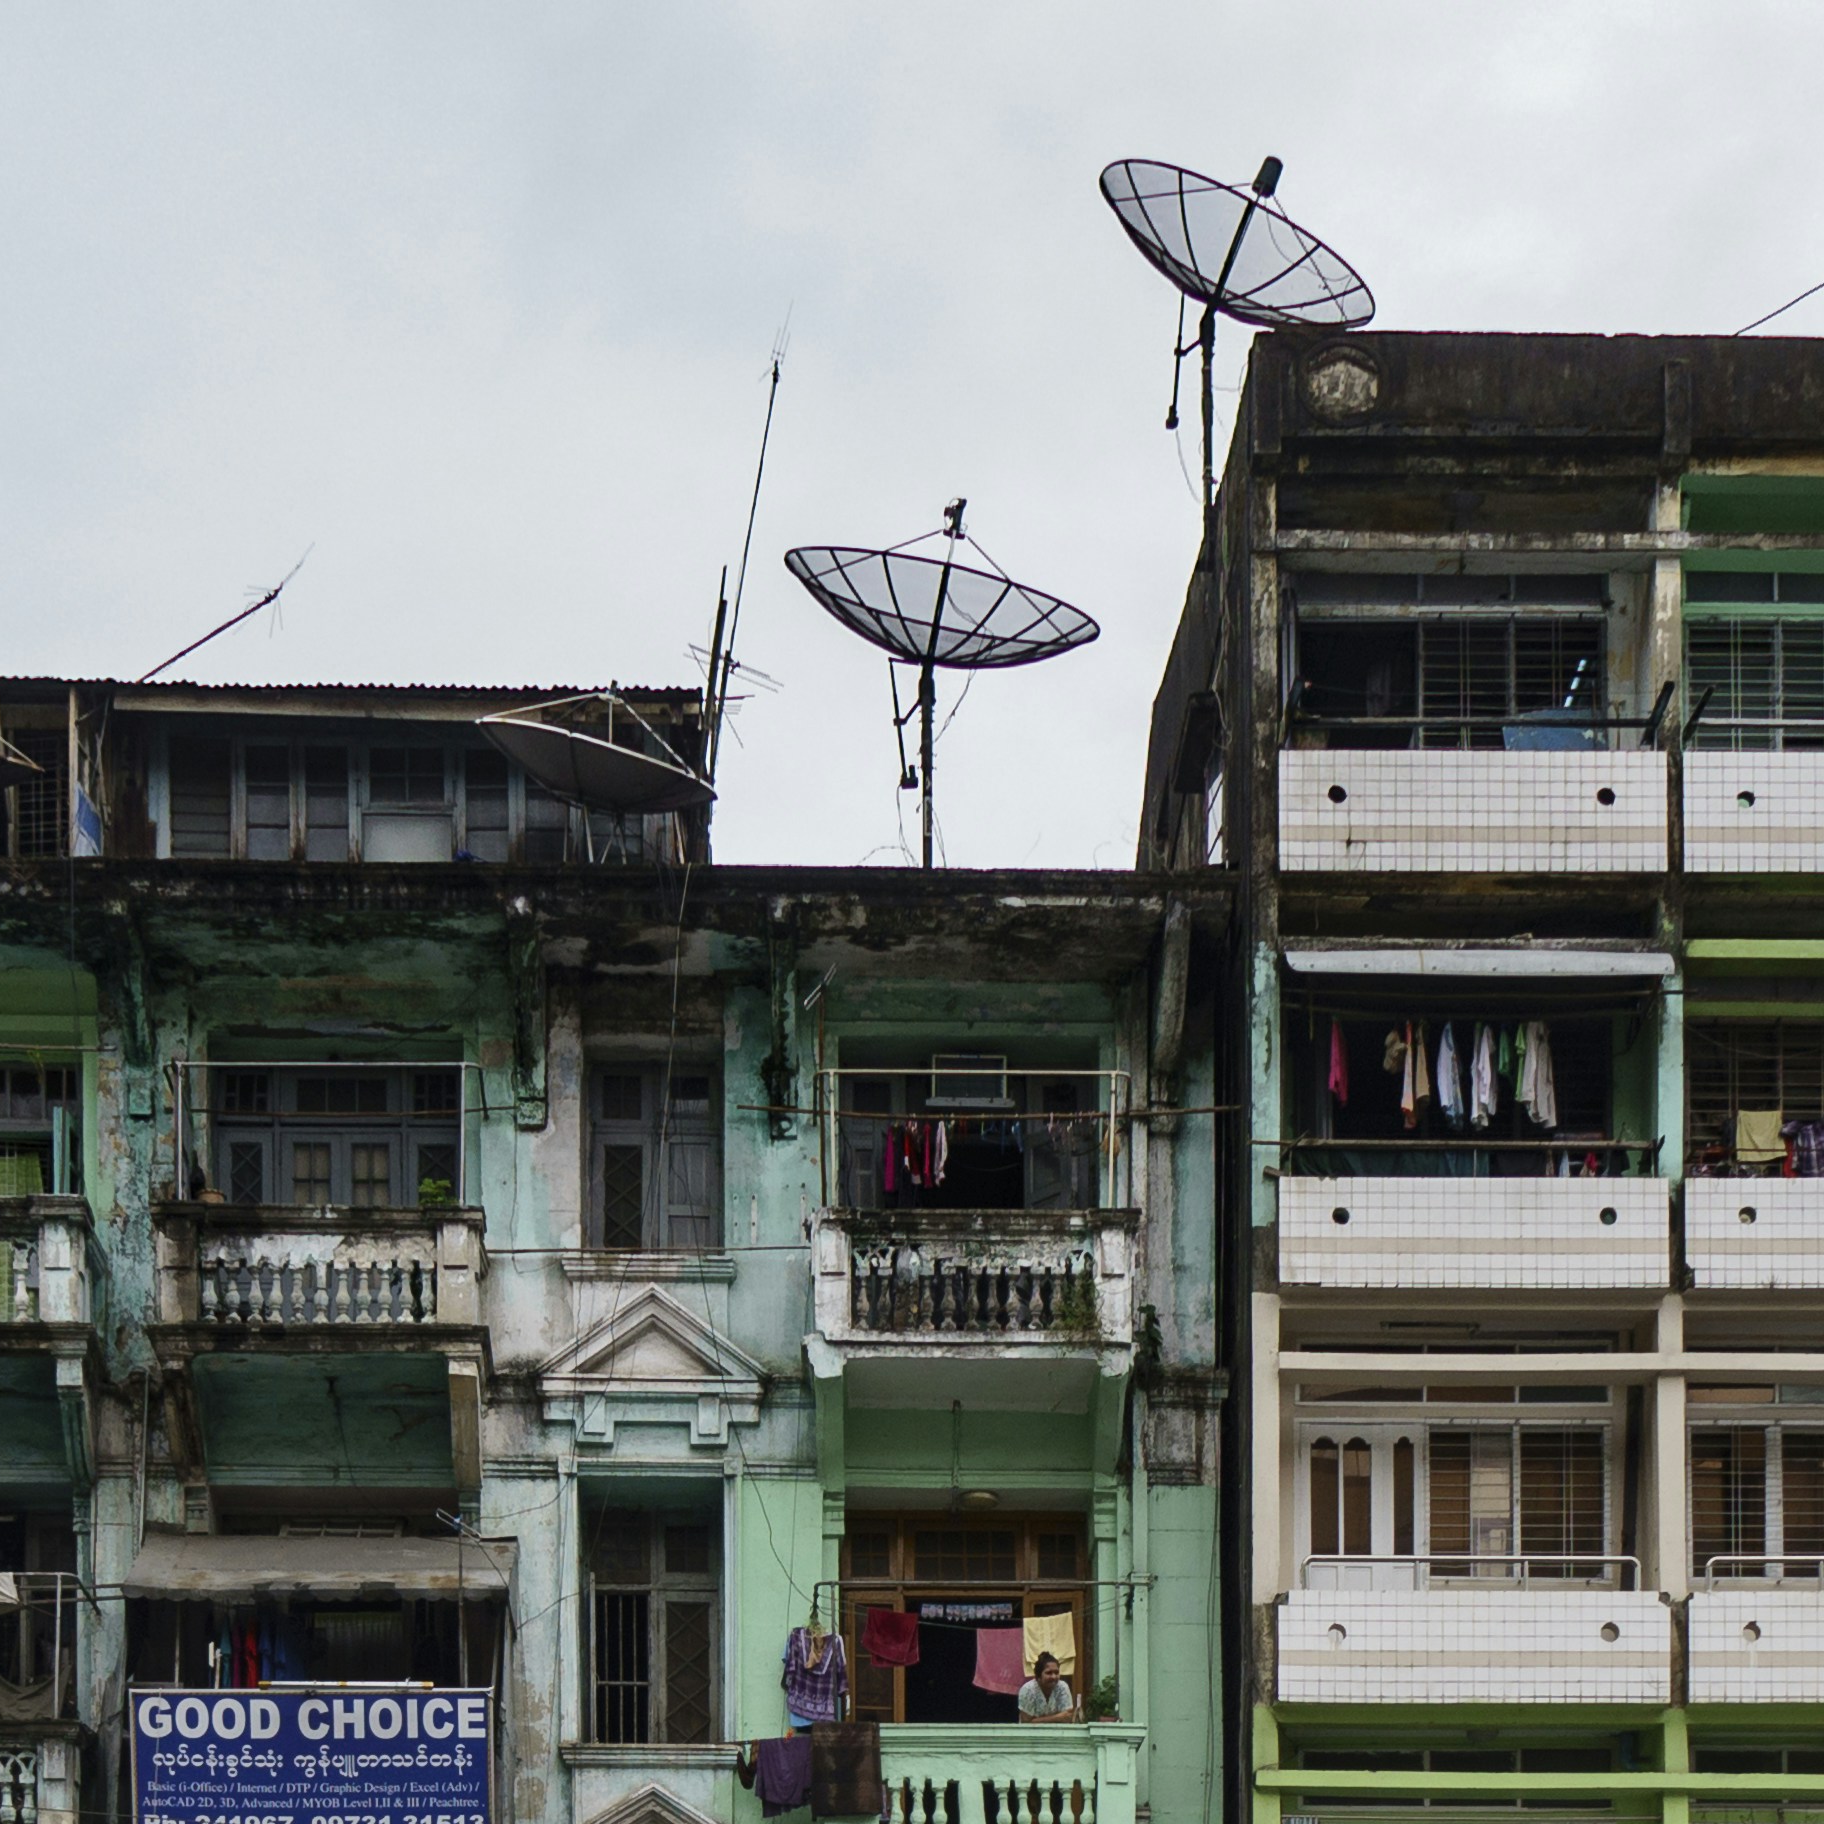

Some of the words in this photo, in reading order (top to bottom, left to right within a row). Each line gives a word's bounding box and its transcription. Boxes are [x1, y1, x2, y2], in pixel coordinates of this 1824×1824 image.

[138, 1697, 280, 1739] GOOD
[298, 1697, 486, 1740] CHOICE
[147, 1781, 176, 1792] Basic
[237, 1782, 277, 1793] Internet
[286, 1783, 311, 1793] DTP
[320, 1782, 361, 1795] Graphic
[364, 1782, 401, 1795] Design
[410, 1782, 439, 1792] Excel
[442, 1782, 473, 1793] (Adv)
[142, 1797, 195, 1808] AutoCAD
[242, 1797, 293, 1808] Advanced
[303, 1798, 340, 1808] MYOB
[343, 1798, 372, 1808] Level
[429, 1797, 479, 1808] Peachtree
